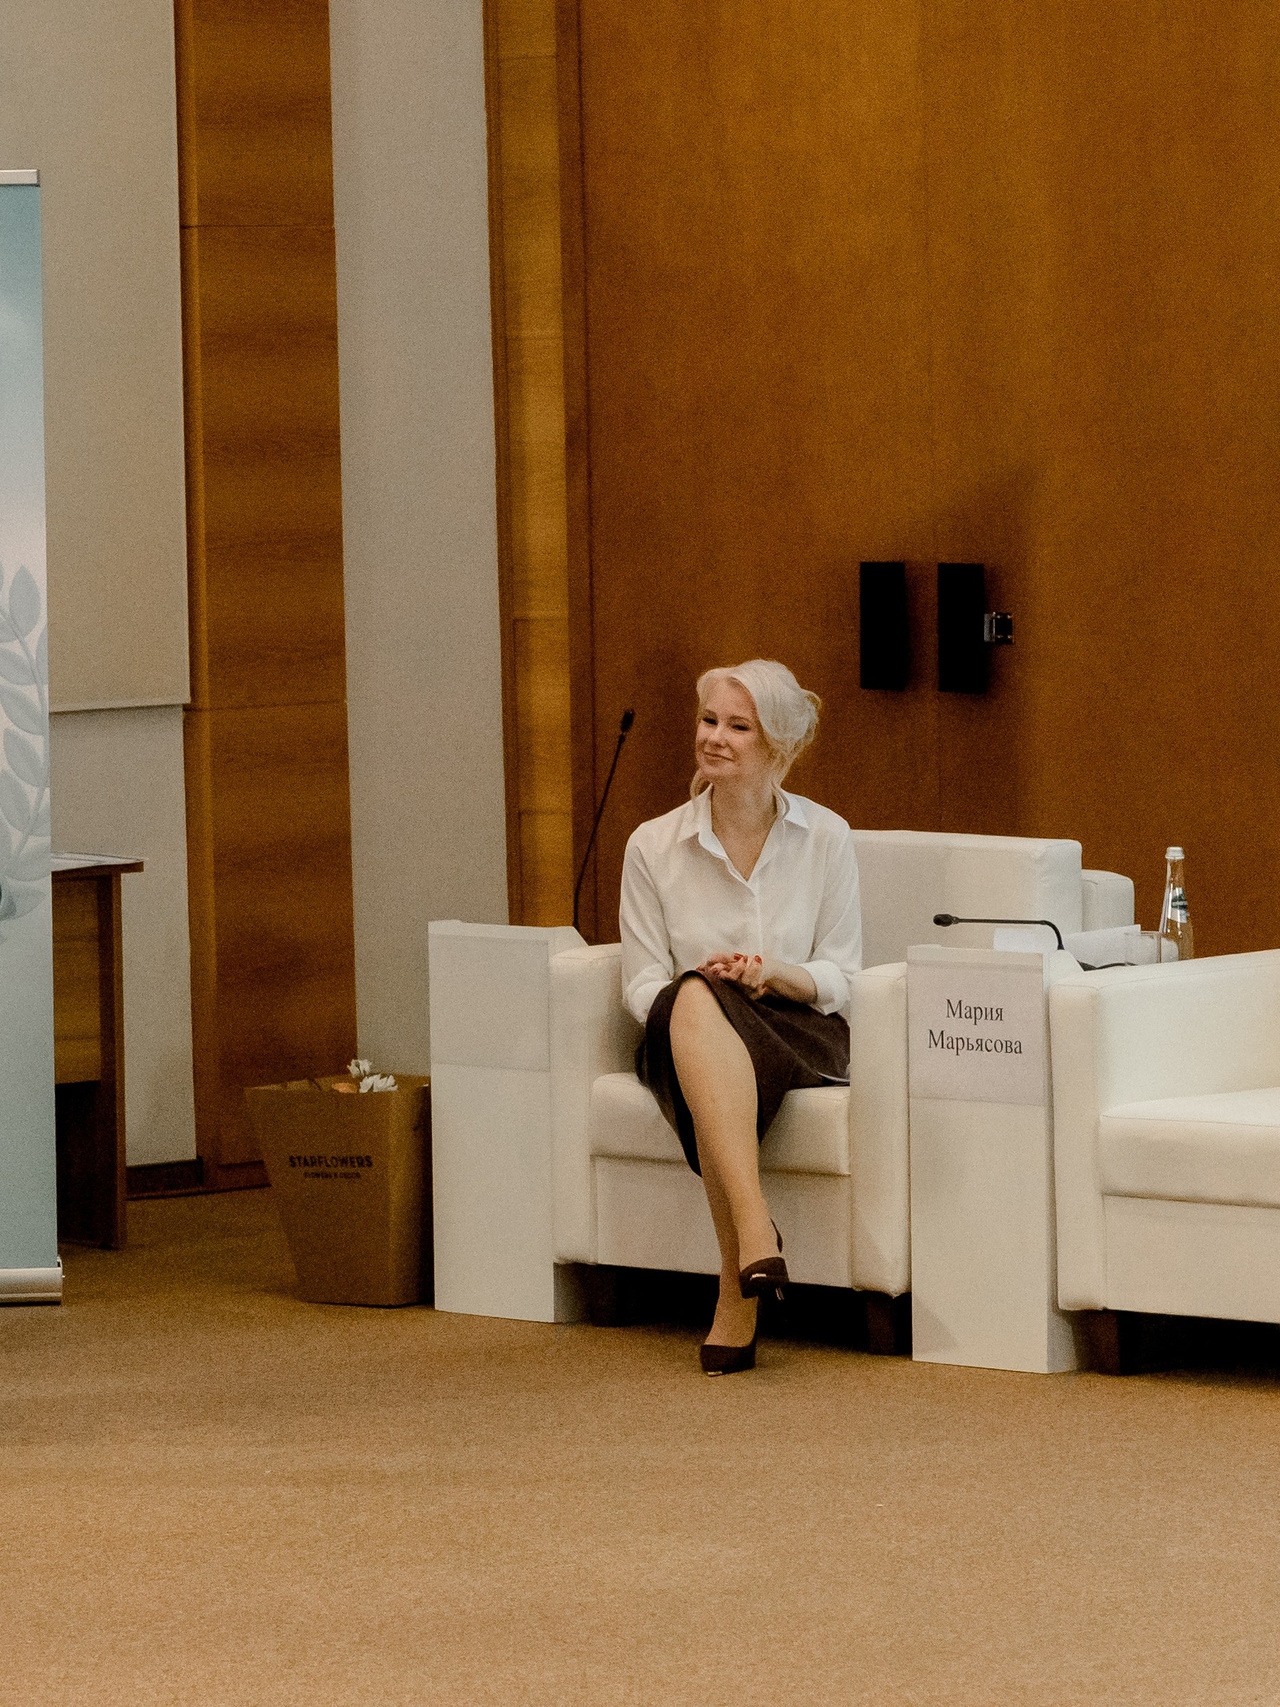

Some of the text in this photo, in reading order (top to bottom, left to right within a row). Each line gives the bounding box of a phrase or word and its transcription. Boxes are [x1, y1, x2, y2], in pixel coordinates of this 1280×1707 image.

[946, 998, 1004, 1026] Мария
[928, 1028, 1023, 1056] Марьясова
[289, 1154, 373, 1168] STARFLOWERS
